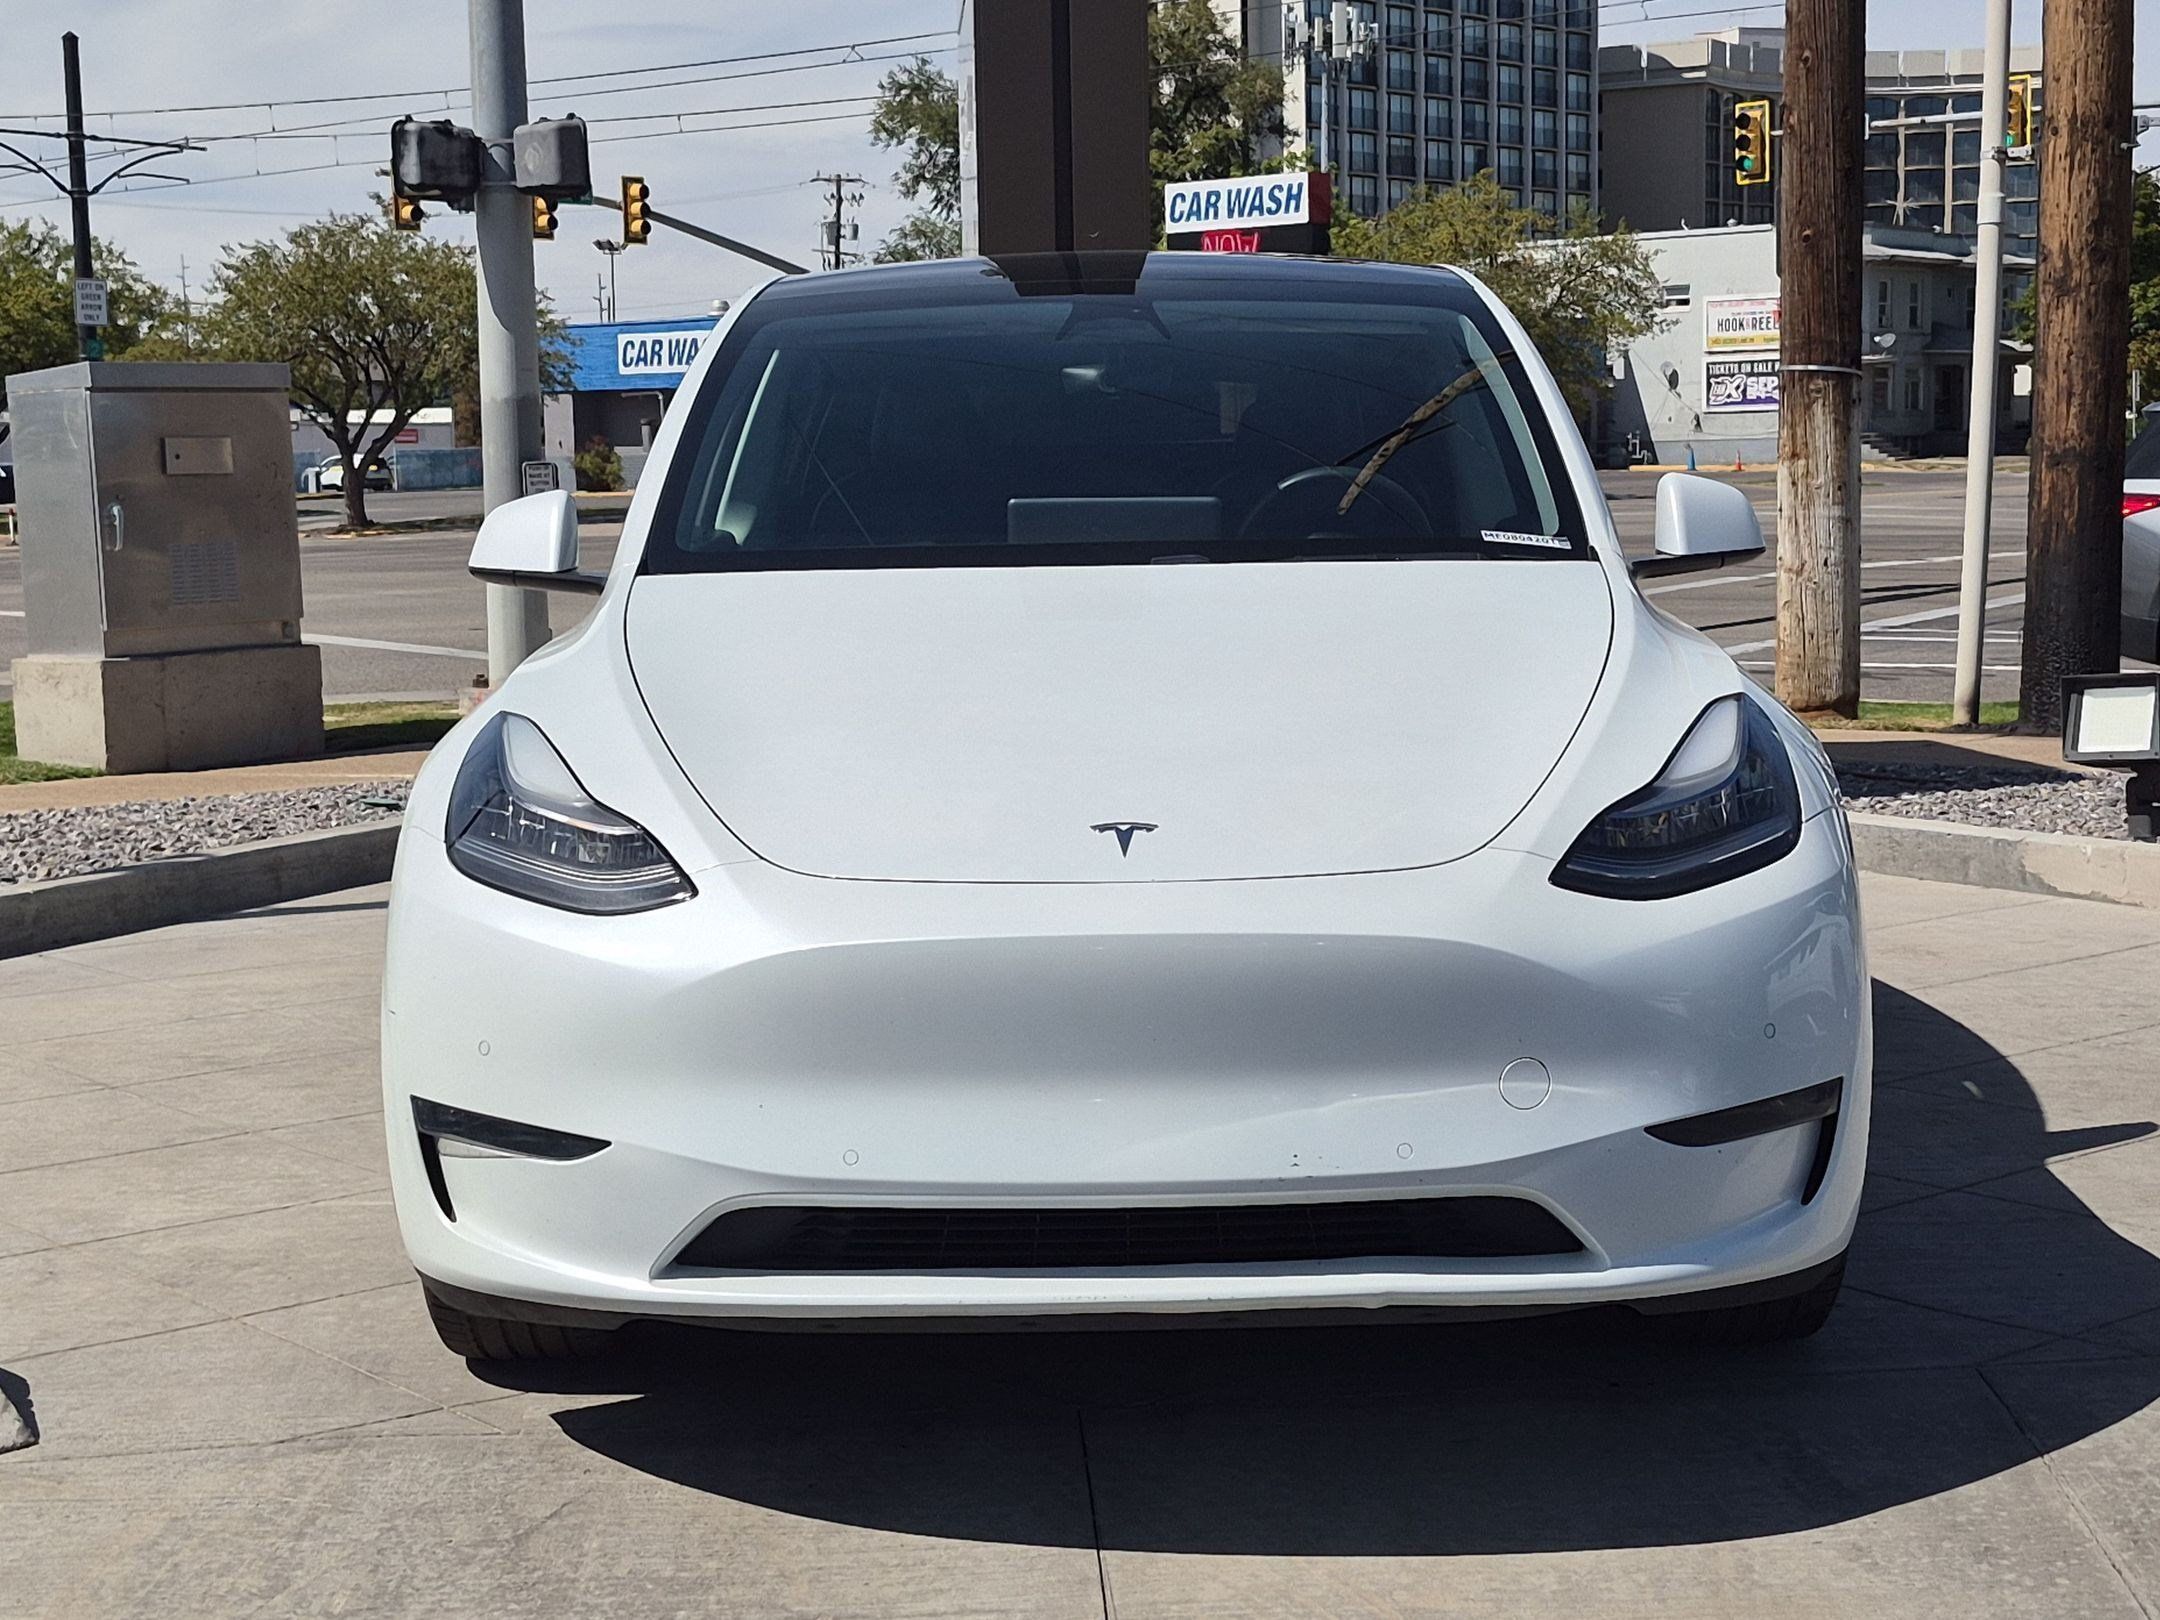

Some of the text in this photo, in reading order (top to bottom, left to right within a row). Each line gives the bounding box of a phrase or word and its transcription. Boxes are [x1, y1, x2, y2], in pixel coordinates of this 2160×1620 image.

[1170, 182, 1304, 223] CAR WASH
[1717, 317, 1745, 333] HOOK
[1751, 316, 1780, 331] REEL
[622, 339, 664, 368] CAR
[1740, 362, 1752, 373] ON
[1753, 361, 1773, 373] SALE
